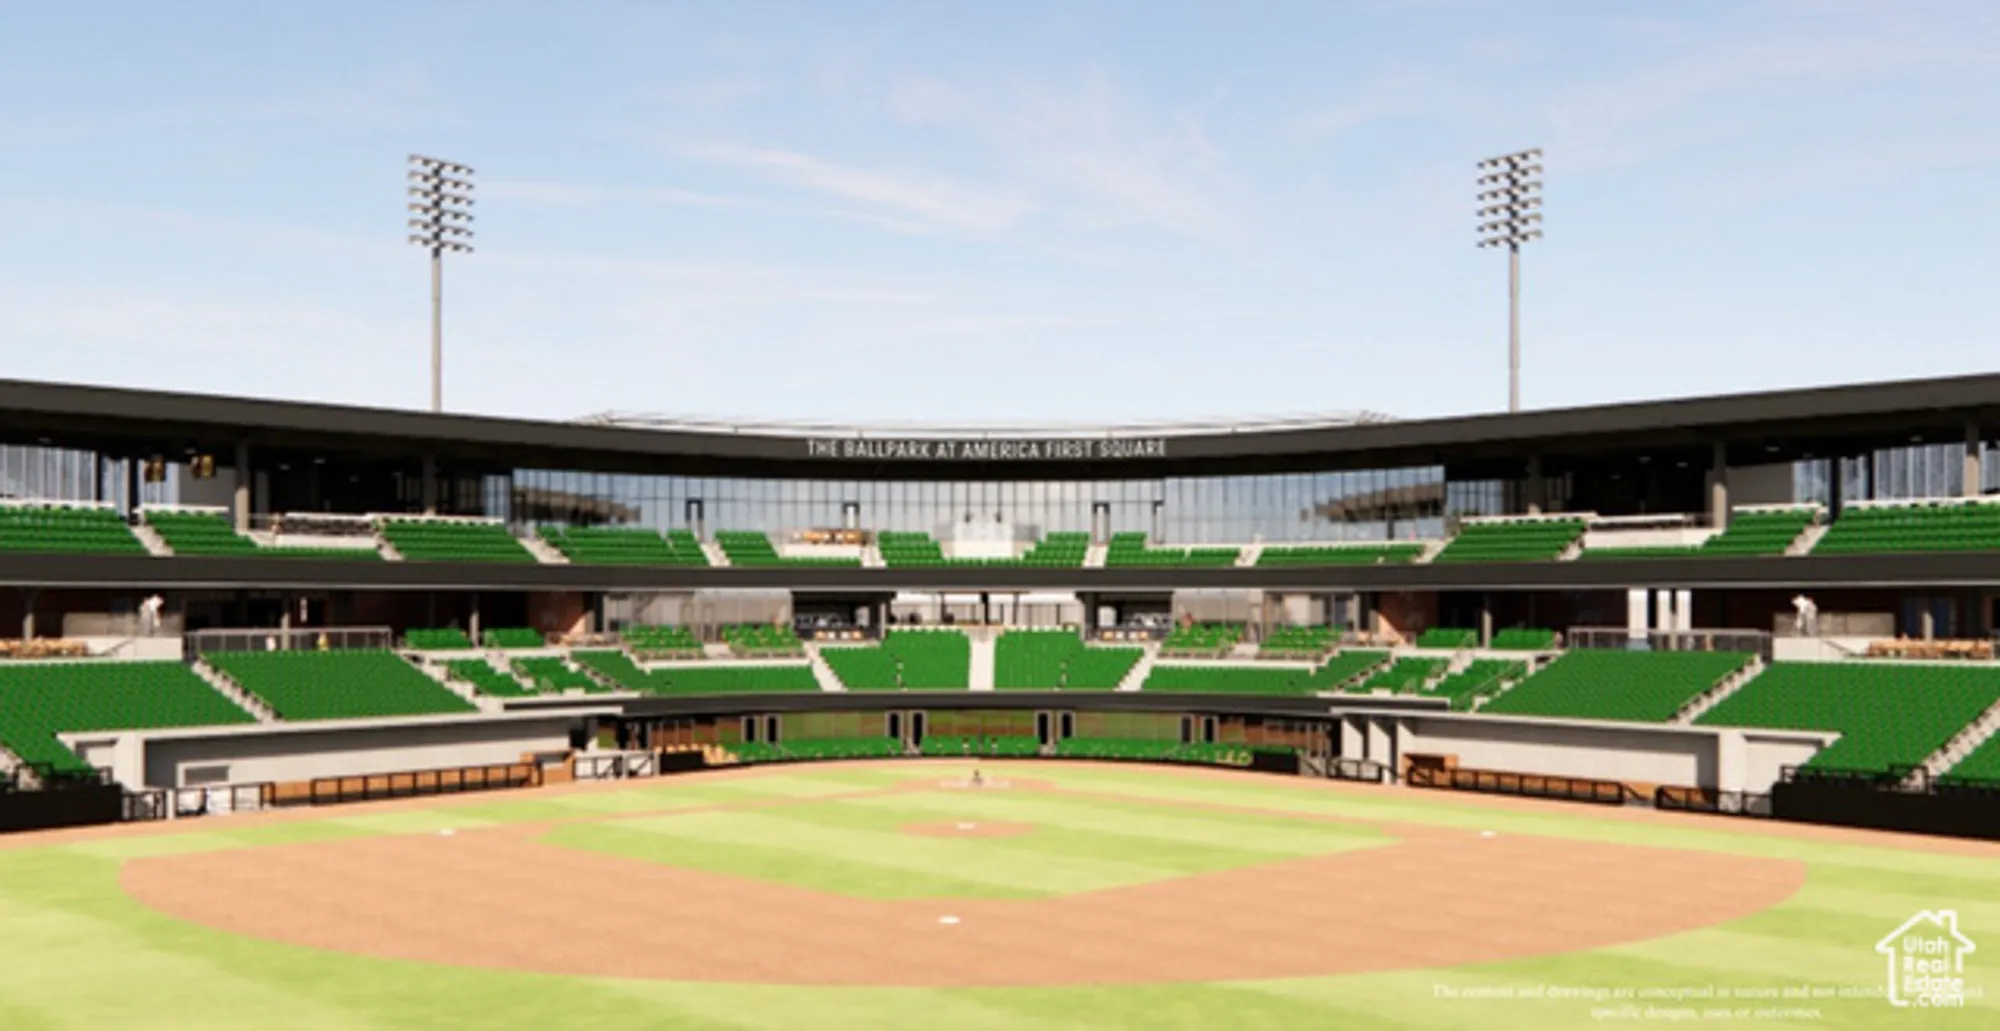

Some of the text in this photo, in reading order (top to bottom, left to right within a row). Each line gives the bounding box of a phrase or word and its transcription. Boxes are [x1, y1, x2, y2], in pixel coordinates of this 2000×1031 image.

[808, 439, 1167, 458] THE BALLPARK AT AMERICA FIRST SQUARE
